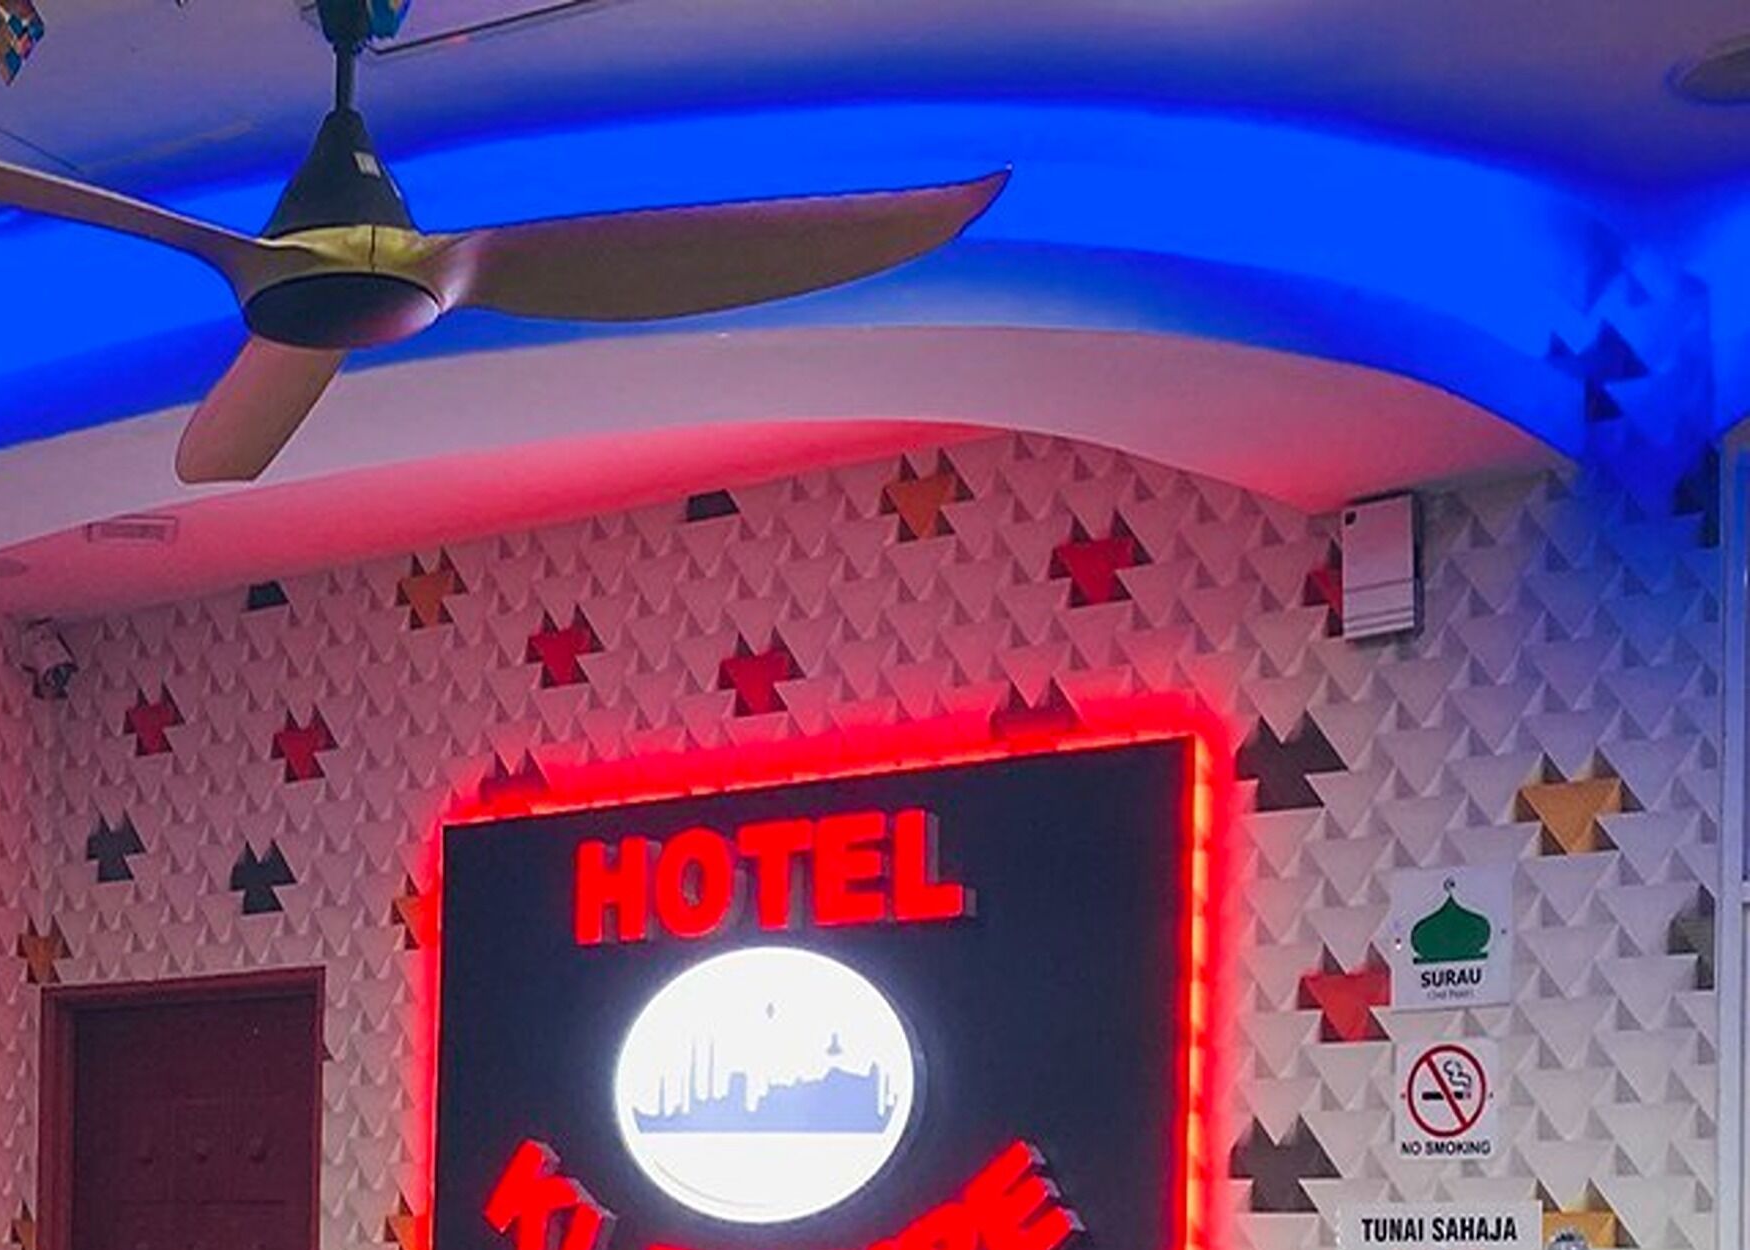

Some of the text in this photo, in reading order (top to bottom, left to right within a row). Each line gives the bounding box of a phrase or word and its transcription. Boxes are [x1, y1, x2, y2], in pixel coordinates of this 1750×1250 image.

[574, 808, 977, 946] HOTEL
[1421, 968, 1482, 988] SURAU
[1401, 1140, 1491, 1155] NO SMOKING
[1361, 1217, 1518, 1243] TUNAI SAHAJA
